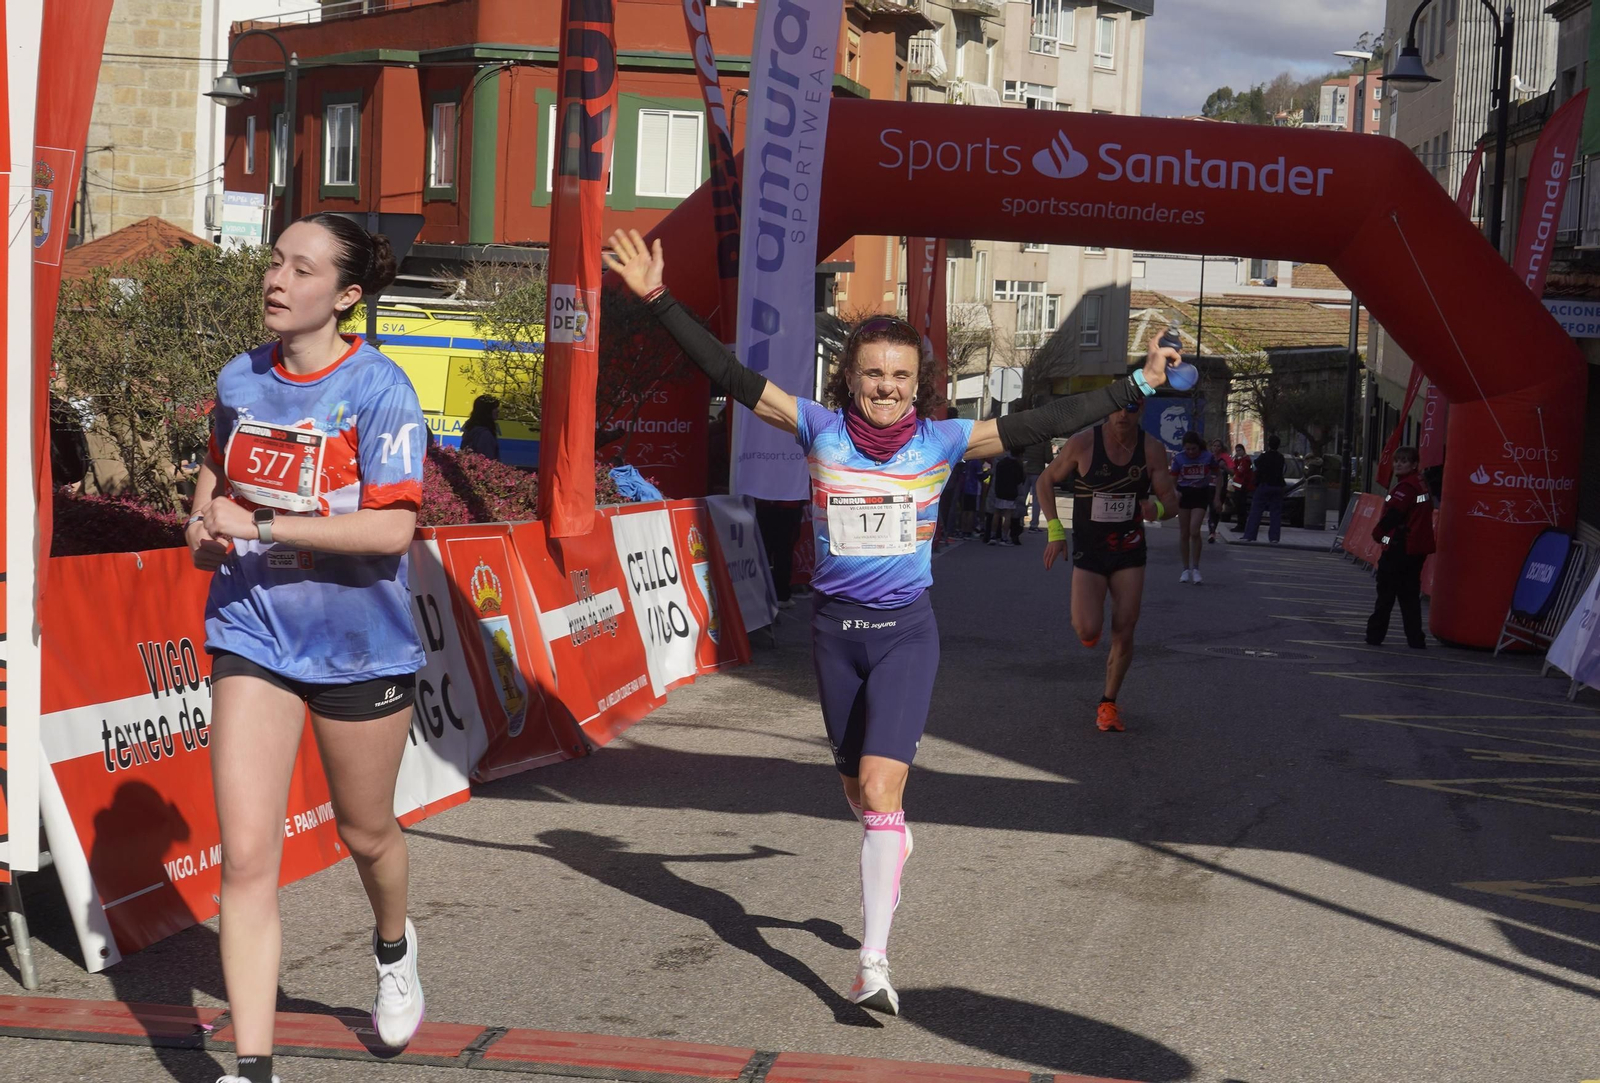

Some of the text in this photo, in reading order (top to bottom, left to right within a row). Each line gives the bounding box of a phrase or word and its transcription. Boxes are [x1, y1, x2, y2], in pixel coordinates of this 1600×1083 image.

[756, 0, 810, 273] amura
[790, 45, 828, 244] SPORTWEAR
[878, 128, 1333, 196] Sports Santander
[1001, 197, 1205, 225] sportssantander.es
[1525, 146, 1566, 290] antander
[382, 323, 406, 332] SVA
[604, 417, 692, 434] Santander
[247, 447, 295, 479] 577
[1502, 441, 1560, 463] Sports
[1493, 471, 1575, 491] Santander
[1104, 502, 1125, 512] 149
[859, 512, 886, 533] 17
[101, 697, 210, 773] terreo de
[293, 809, 319, 834] PARA
